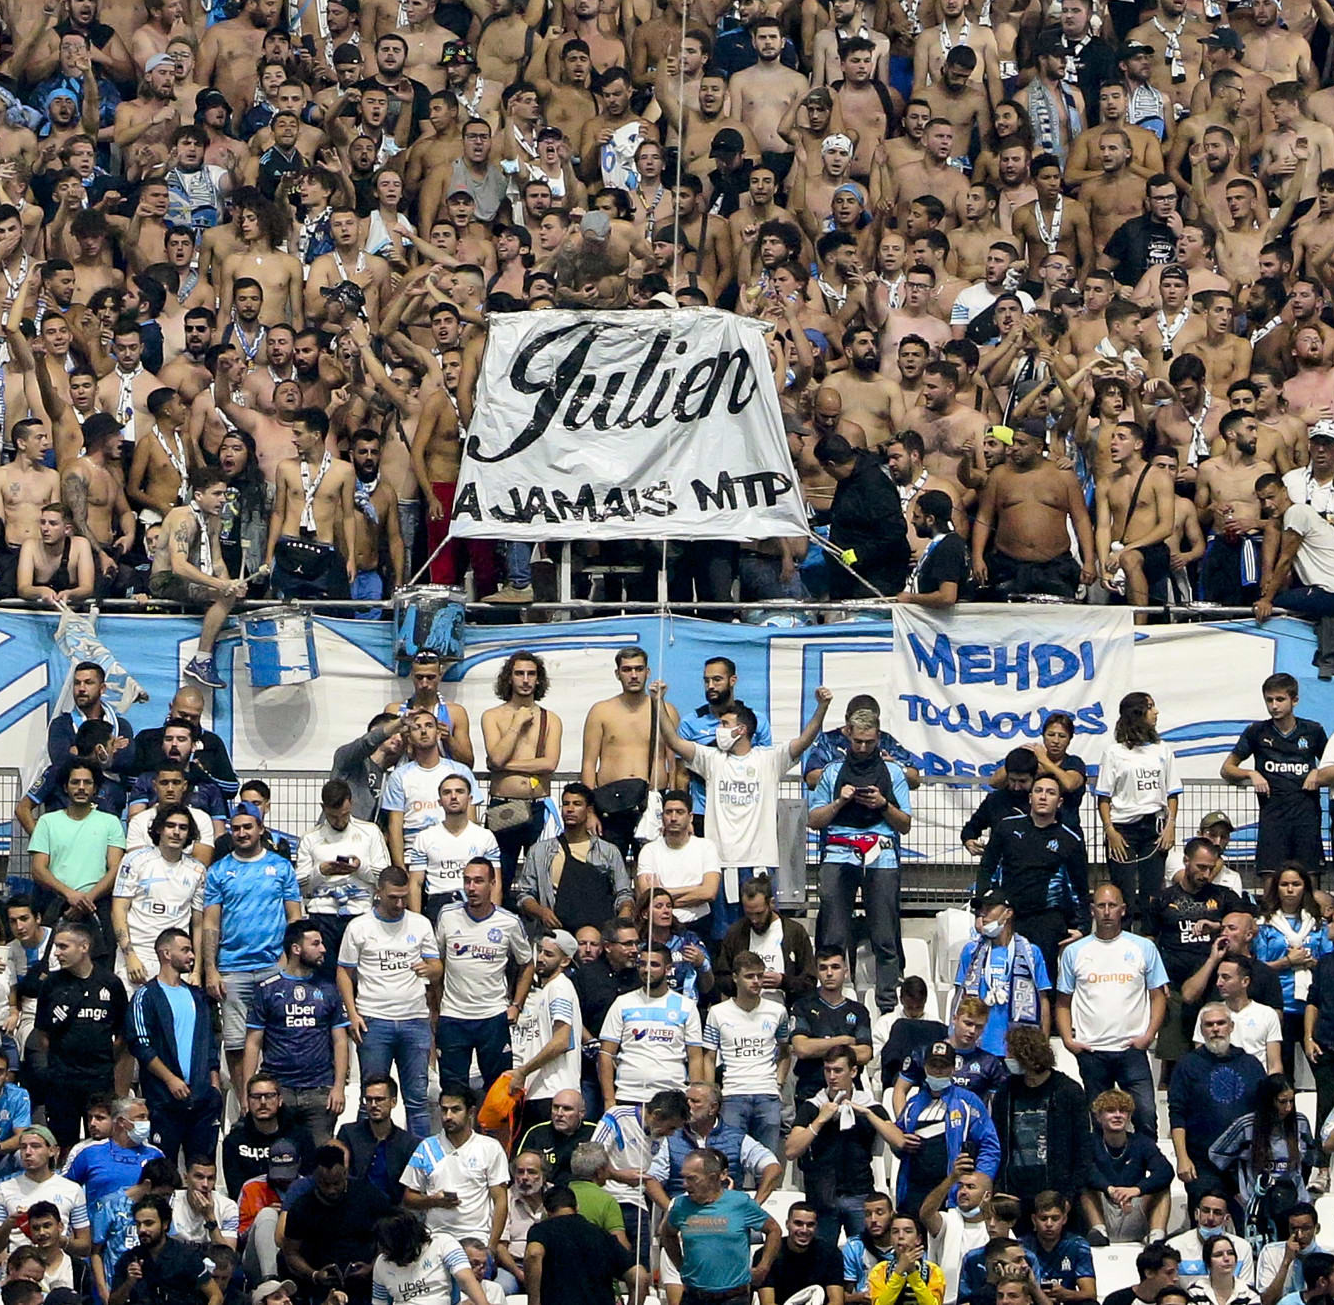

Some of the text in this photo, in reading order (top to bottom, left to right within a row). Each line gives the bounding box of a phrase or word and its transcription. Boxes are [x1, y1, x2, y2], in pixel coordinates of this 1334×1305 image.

[467, 321, 759, 463] Julien
[451, 470, 794, 524] A JAMAIS MTP
[907, 632, 1096, 691] MEHDI
[1135, 768, 1161, 780] Uber
[1264, 760, 1309, 776] Orange
[1137, 779, 1162, 790] Eats
[471, 944, 499, 955] INTER
[378, 950, 408, 962] Uber
[380, 960, 409, 971] Eats
[1086, 972, 1133, 985] Orange
[76, 1006, 108, 1021] ange
[284, 1003, 316, 1015] Uber
[285, 1015, 316, 1027] Eats
[646, 1027, 674, 1038] INTER
[734, 1034, 766, 1046] Uber
[734, 1045, 765, 1056] Eats
[398, 1276, 427, 1294] Uber
